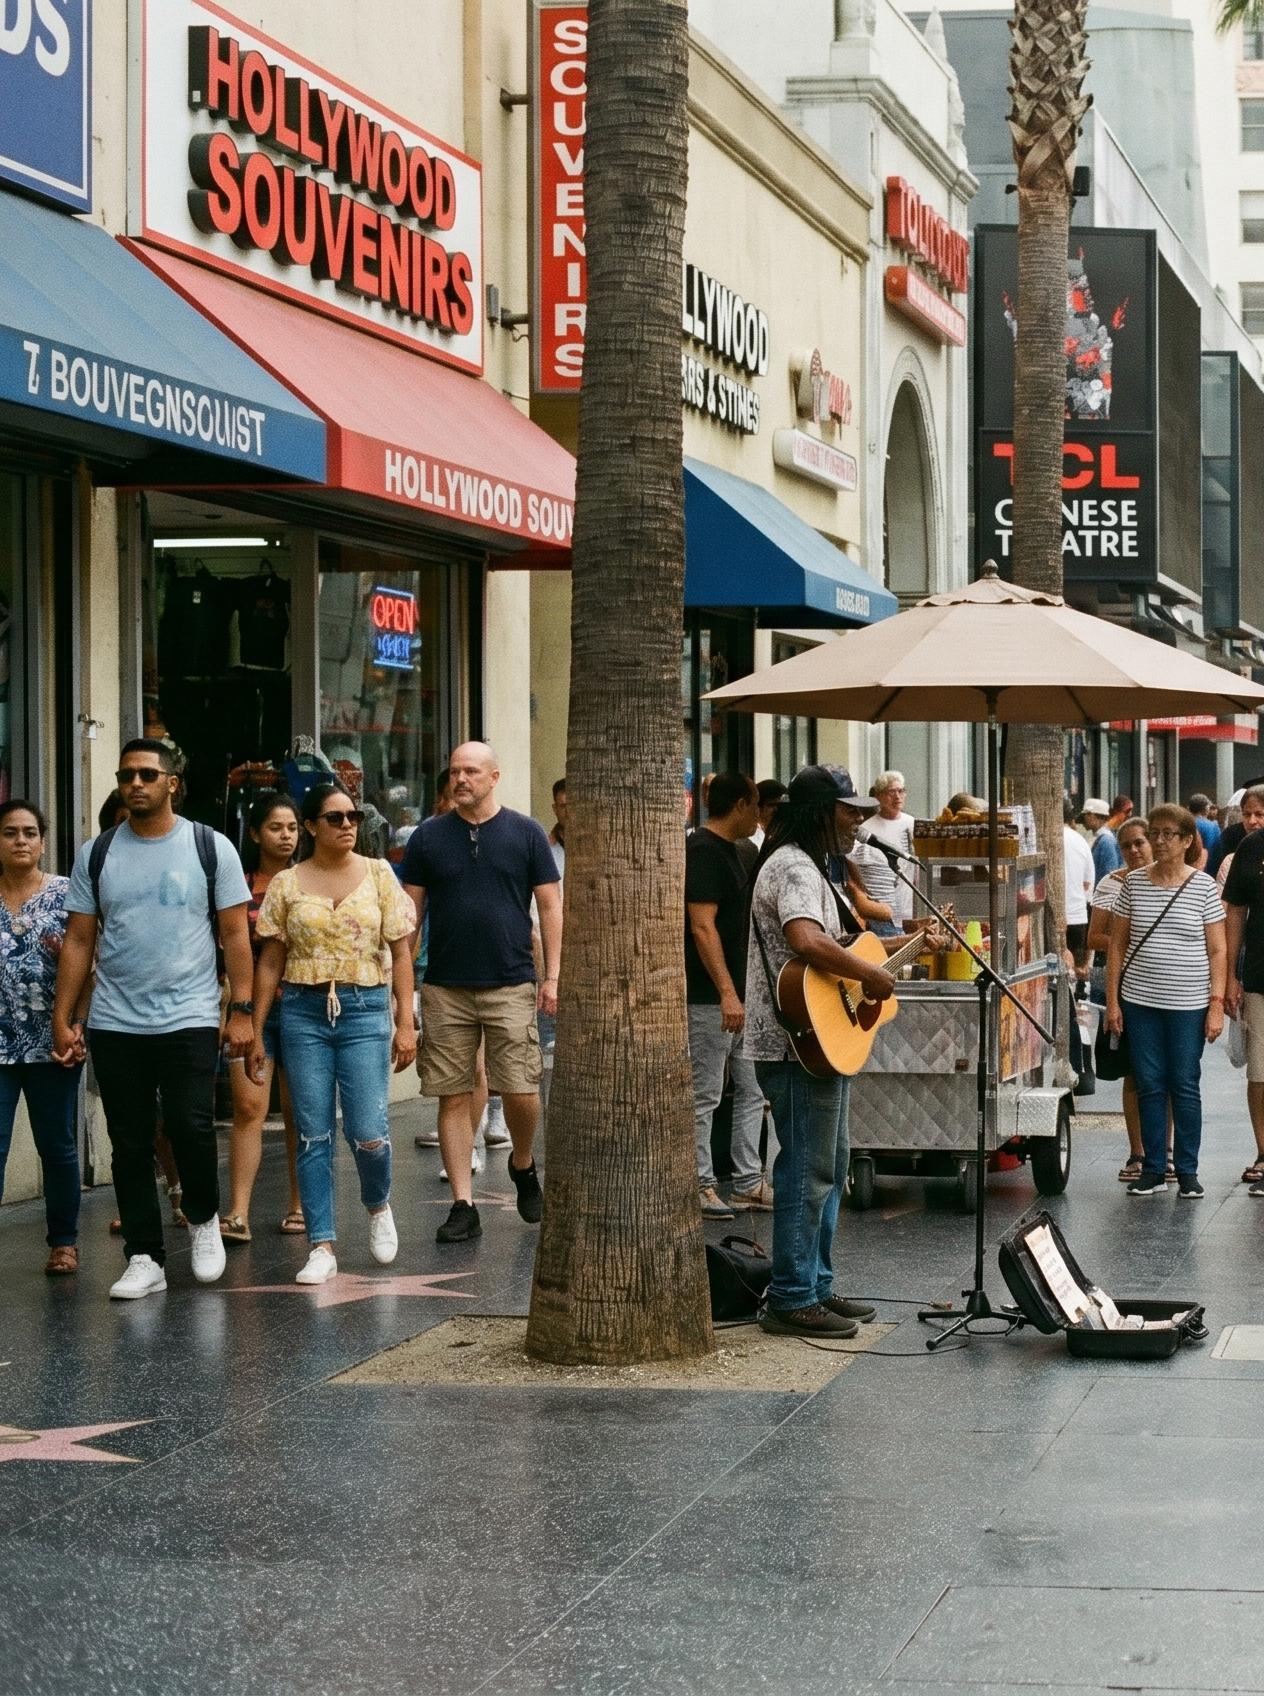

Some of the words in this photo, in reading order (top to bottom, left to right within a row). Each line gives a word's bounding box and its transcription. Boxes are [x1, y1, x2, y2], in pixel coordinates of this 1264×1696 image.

[205, 25, 457, 232] HOLLYWOOD
[205, 132, 475, 336] SOUVENIRS
[550, 19, 588, 378] SOUVENIRS
[385, 449, 522, 528] HOLLYWOOD
[994, 498, 1138, 527] CNESE
[994, 529, 1139, 557] TATRE
[373, 595, 415, 635] OPEN
